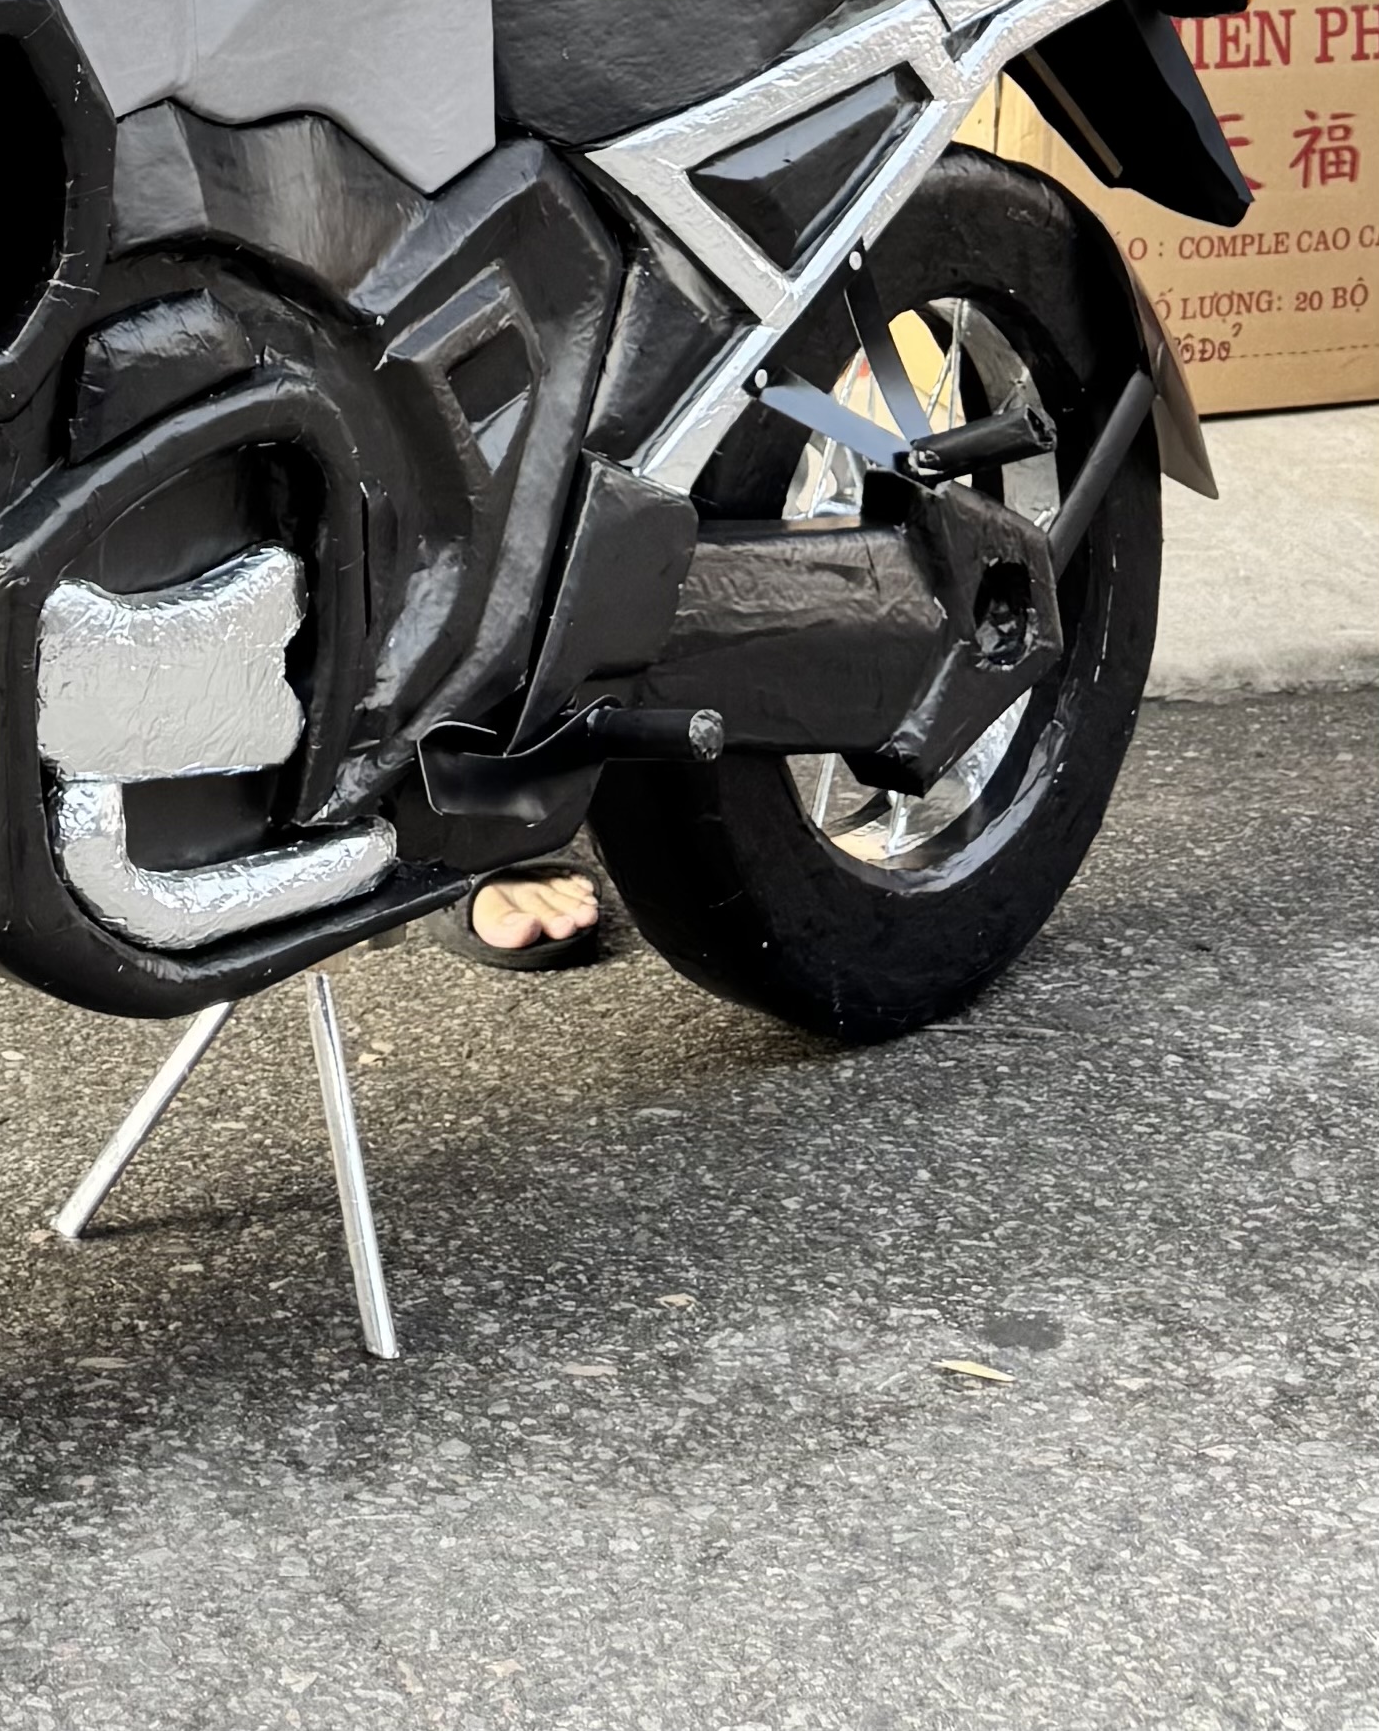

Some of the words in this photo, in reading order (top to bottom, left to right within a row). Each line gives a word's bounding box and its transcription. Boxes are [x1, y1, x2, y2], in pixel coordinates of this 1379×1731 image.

[1170, 9, 1297, 70] IEN
[1314, 3, 1379, 64] PH
[1178, 231, 1290, 260] COMPLE
[1296, 227, 1351, 253] CAO
[1358, 224, 1379, 248] C
[1155, 287, 1173, 321] Ố
[1181, 289, 1282, 324] LƯỢNG:
[1294, 290, 1323, 312] 20
[1332, 276, 1369, 313] BỘ
